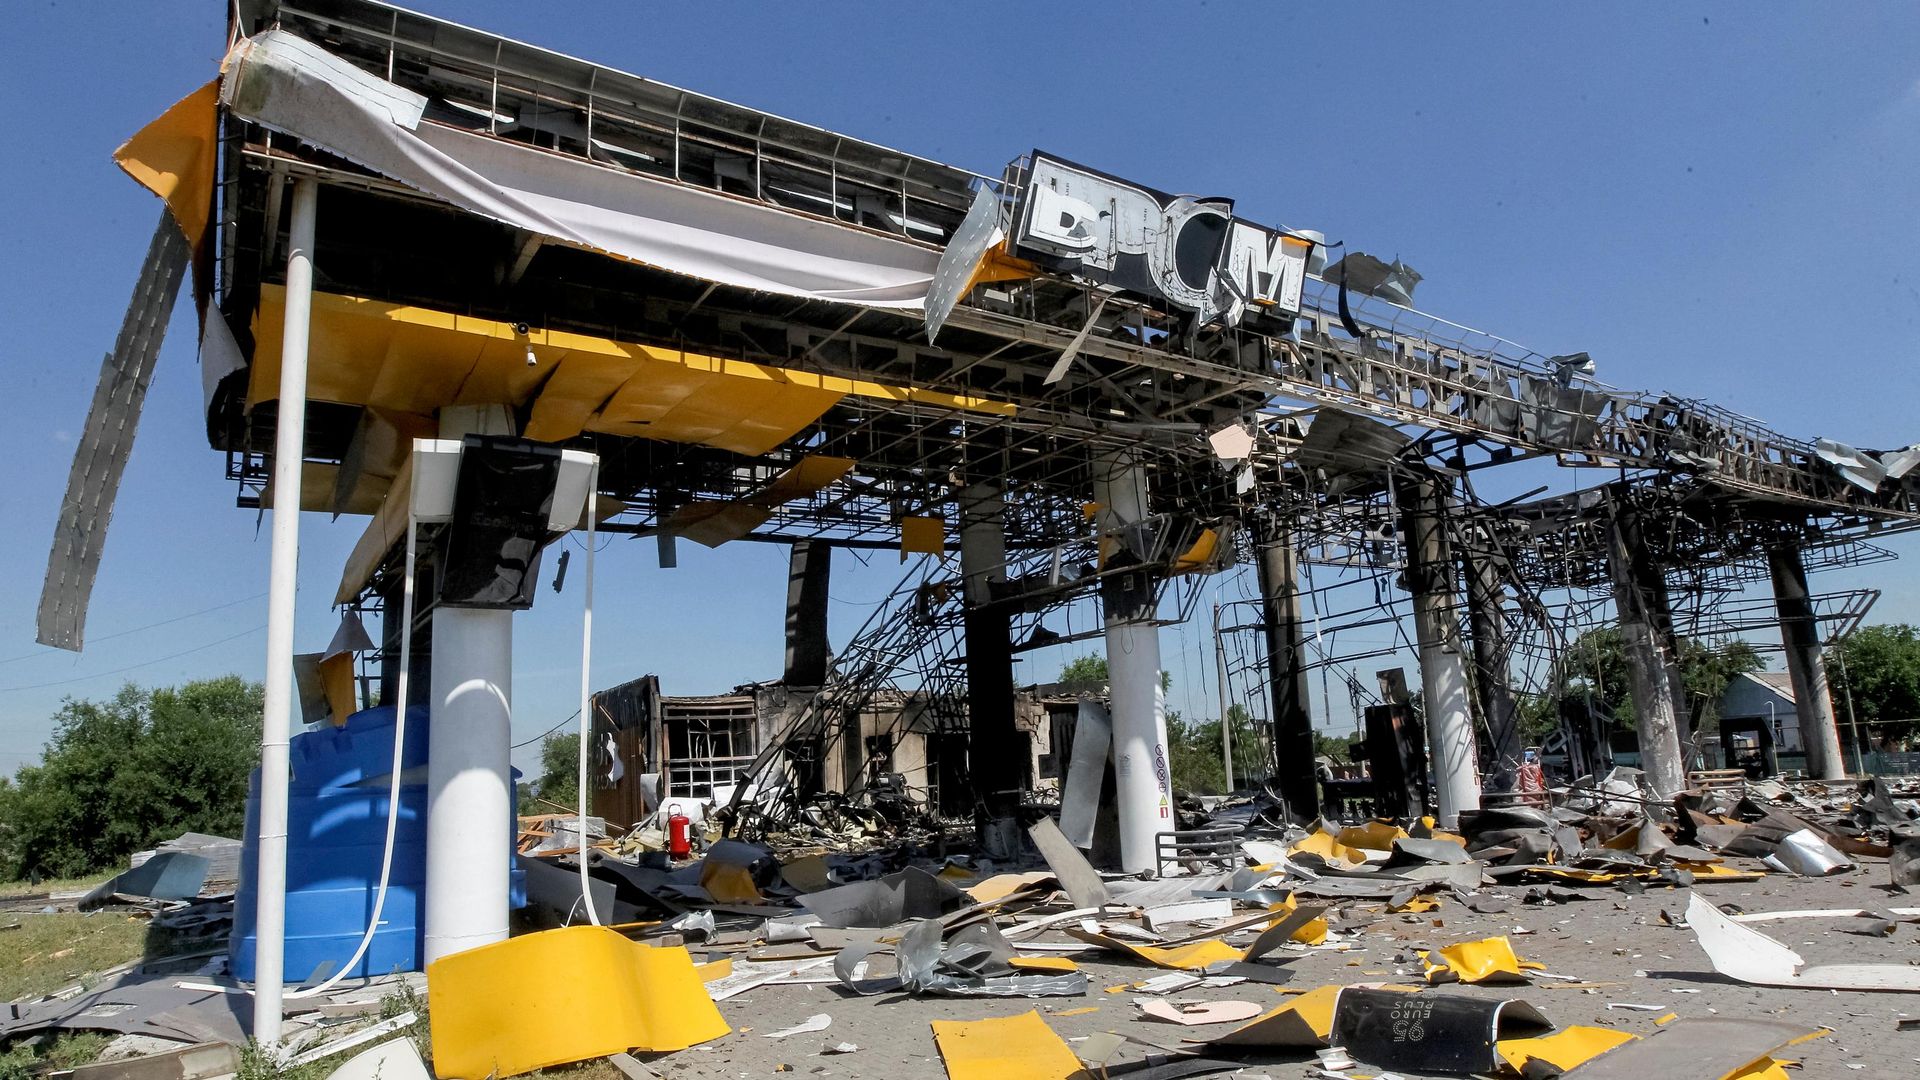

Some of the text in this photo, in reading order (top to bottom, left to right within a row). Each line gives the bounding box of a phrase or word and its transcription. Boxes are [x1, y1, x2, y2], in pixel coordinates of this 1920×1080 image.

[1393, 1000, 1435, 1009] PLUS
[1390, 1009, 1432, 1019] EURO
[1393, 1019, 1424, 1042] 95
